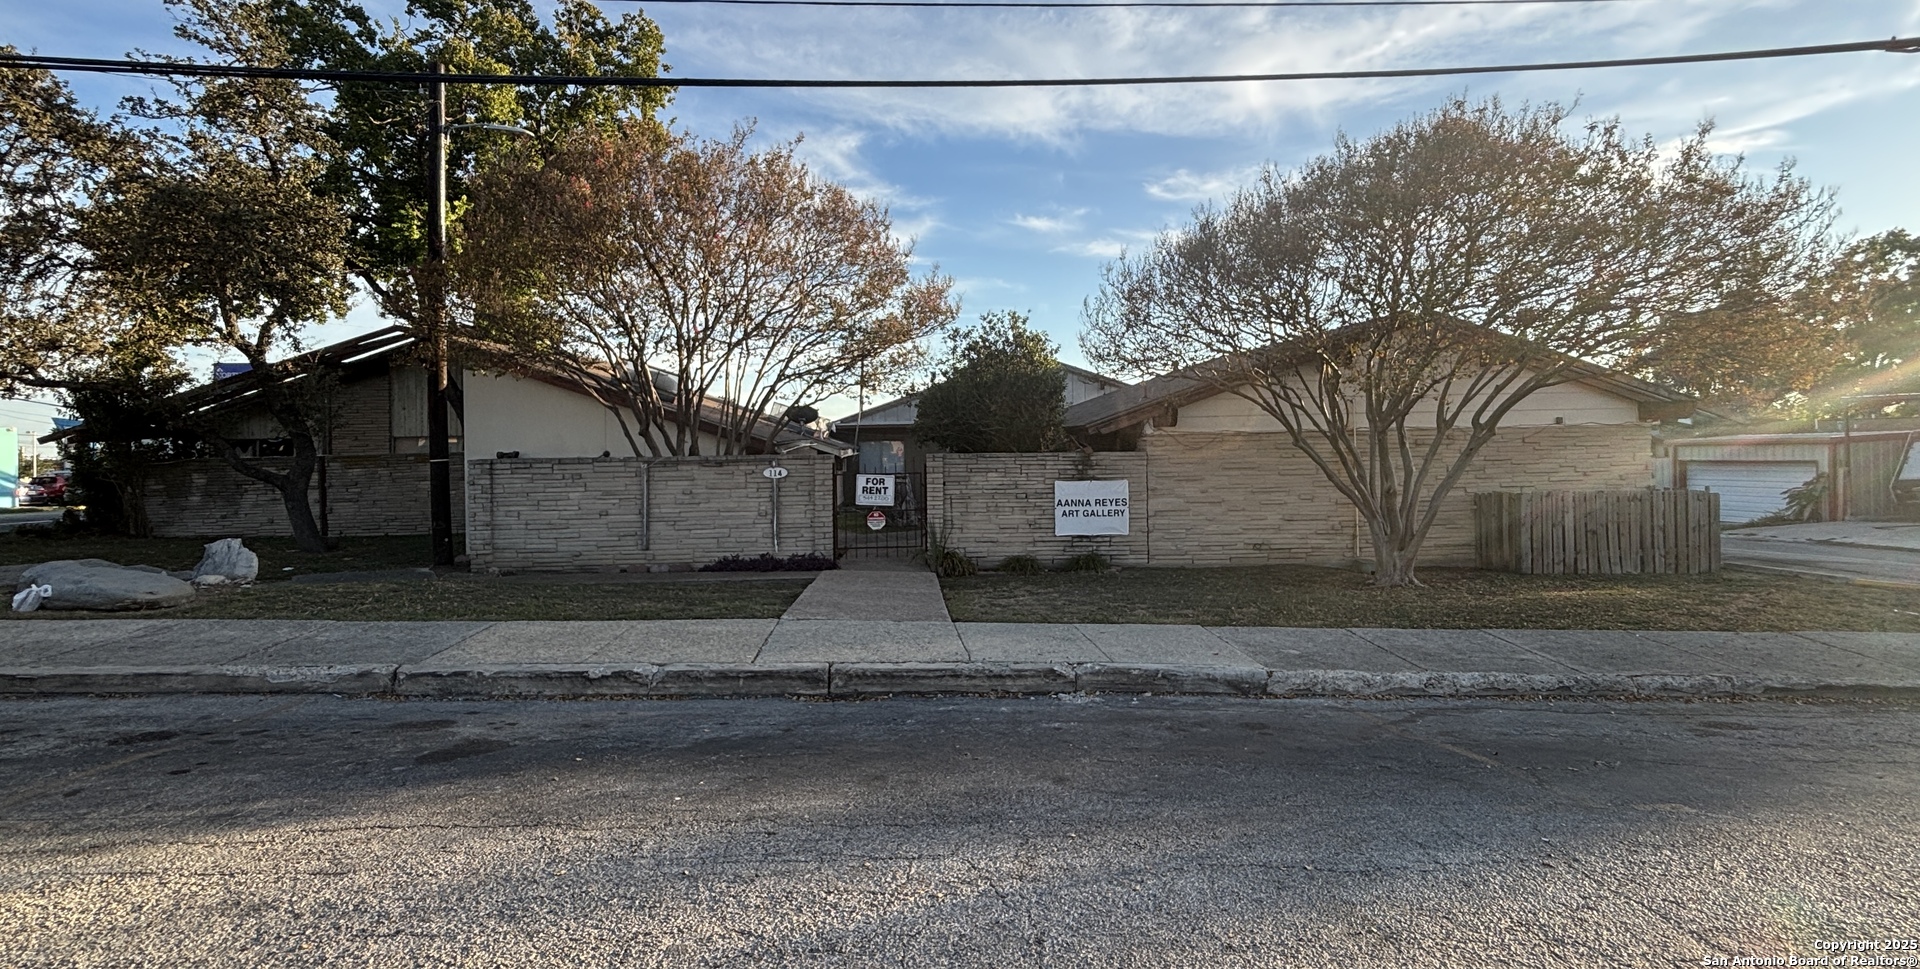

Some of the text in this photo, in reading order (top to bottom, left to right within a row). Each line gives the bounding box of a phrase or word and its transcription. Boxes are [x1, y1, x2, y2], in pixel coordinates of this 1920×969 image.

[769, 469, 782, 477] 114
[865, 477, 886, 486] FOR
[862, 486, 889, 495] RENT
[1056, 497, 1128, 507] AANNA REYES
[1061, 509, 1126, 518] ART GALLERY
